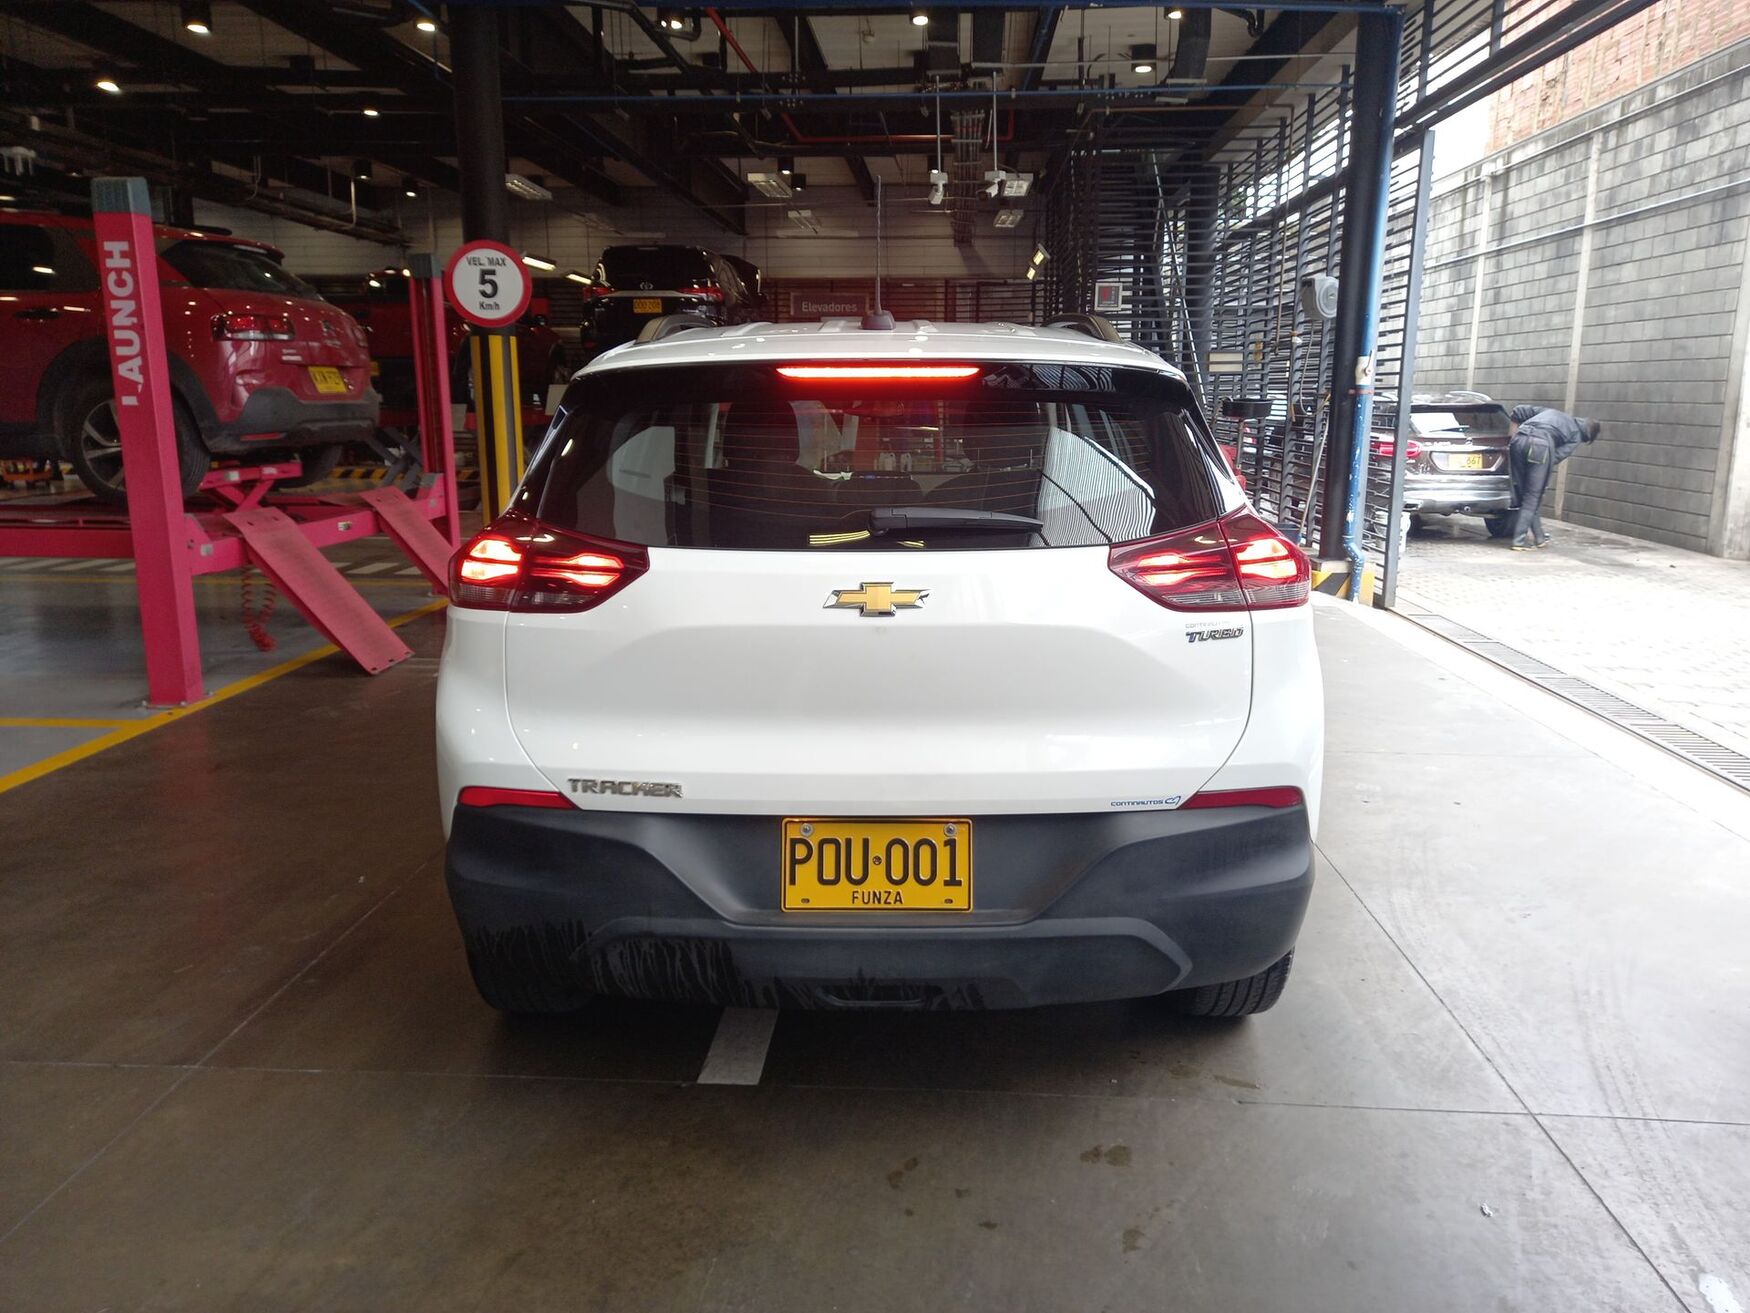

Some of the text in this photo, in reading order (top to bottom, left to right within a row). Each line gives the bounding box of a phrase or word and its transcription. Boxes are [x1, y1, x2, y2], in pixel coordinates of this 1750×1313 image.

[486, 257, 507, 267] MAX
[478, 268, 499, 299] 5
[801, 301, 858, 313] Elevadores
[103, 240, 145, 406] LAUNCH
[1185, 628, 1245, 643] TURBO
[567, 778, 684, 799] TRACKER
[851, 890, 904, 905] FUNZA
